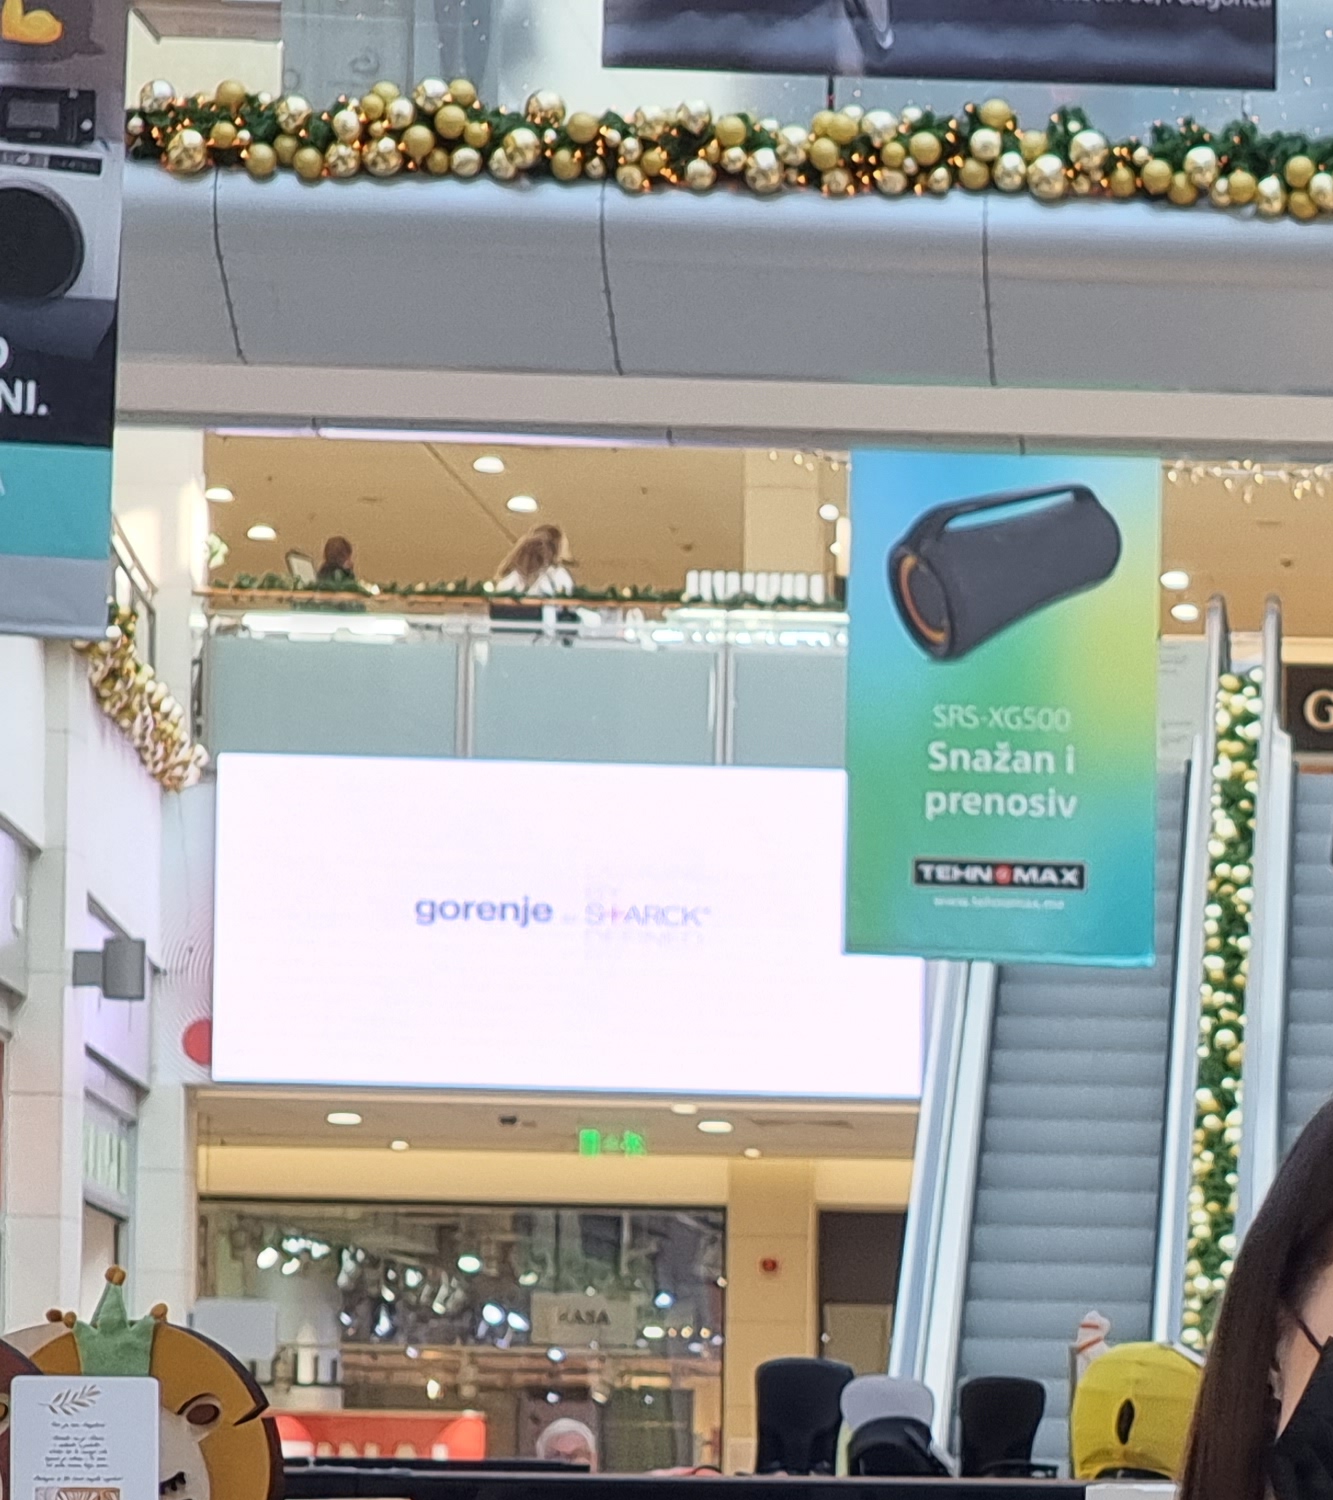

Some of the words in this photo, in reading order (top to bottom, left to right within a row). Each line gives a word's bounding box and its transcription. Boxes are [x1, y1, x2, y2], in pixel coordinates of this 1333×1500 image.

[932, 704, 1072, 732] SRS-XG500
[927, 741, 1056, 775] Snažan
[1066, 744, 1075, 775] i
[925, 787, 1077, 821] prenosiv
[415, 894, 554, 929] gorenje
